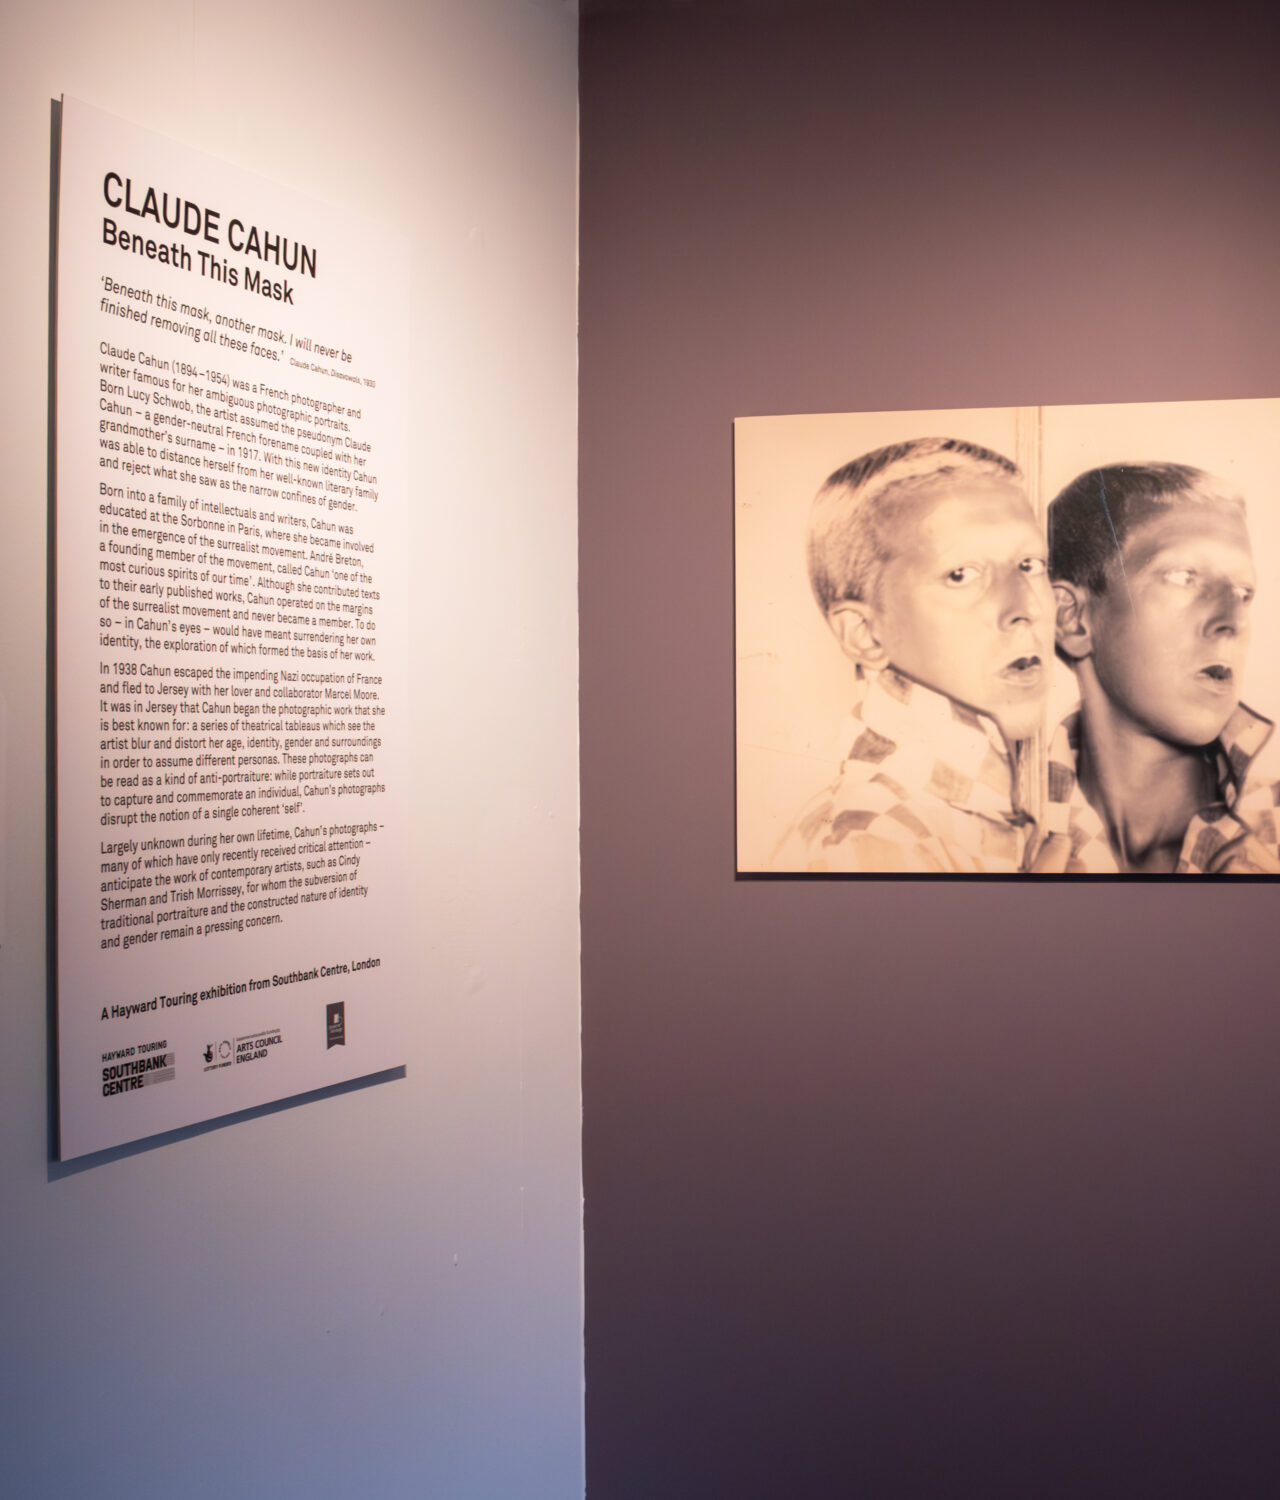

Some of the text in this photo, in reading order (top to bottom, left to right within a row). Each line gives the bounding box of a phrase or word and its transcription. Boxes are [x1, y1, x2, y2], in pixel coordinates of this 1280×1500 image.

[103, 171, 317, 279] CLAUDE CAHUN
[103, 217, 294, 305] Beneath This Mask
[100, 297, 148, 324] finished
[150, 315, 201, 343] removing
[203, 329, 217, 344] all
[219, 333, 248, 353] these
[156, 293, 178, 312] this
[180, 303, 212, 324] mask,
[215, 314, 256, 334] another
[257, 327, 287, 344] mask.
[289, 334, 293, 346] I
[295, 337, 312, 352] will
[313, 344, 340, 359] never
[340, 349, 352, 363] be
[99, 341, 136, 362] Claude
[138, 351, 170, 371] Cahun
[232, 379, 250, 392] was
[251, 384, 258, 394] a
[259, 383, 289, 401] French
[291, 393, 346, 415] photographer
[346, 408, 361, 419] and
[99, 362, 351, 432] writer famous for her ambiguous photographic portraits.
[99, 482, 354, 535] Born into a family of intellectuals and writers, Cahun was
[99, 502, 374, 554] educated at the Sorbonne in Paris, where she became involved
[99, 661, 382, 685] In 1938 Cahun escaped the impending Nazi occupation of France
[99, 680, 380, 700] and fled to Jersey with her lover and collaborator Marcel Moore.
[100, 869, 358, 911] Sherman and Trish Morrissey, for whom the subversion of
[100, 884, 368, 931] traditional portraiture and the constructed nature of identity
[100, 914, 283, 950] and gender remain a pressing concern.
[101, 957, 381, 1021] A Hayward Touring exhibition from Southbank Centre, London
[102, 1040, 167, 1062] HAYWARD TOURING
[102, 1054, 167, 1081] SOUTHBANK
[236, 1041, 253, 1053] ARTS
[255, 1035, 282, 1049] COUNCIL
[236, 1049, 268, 1064] ENGLAND
[102, 1075, 144, 1097] CENTRE
